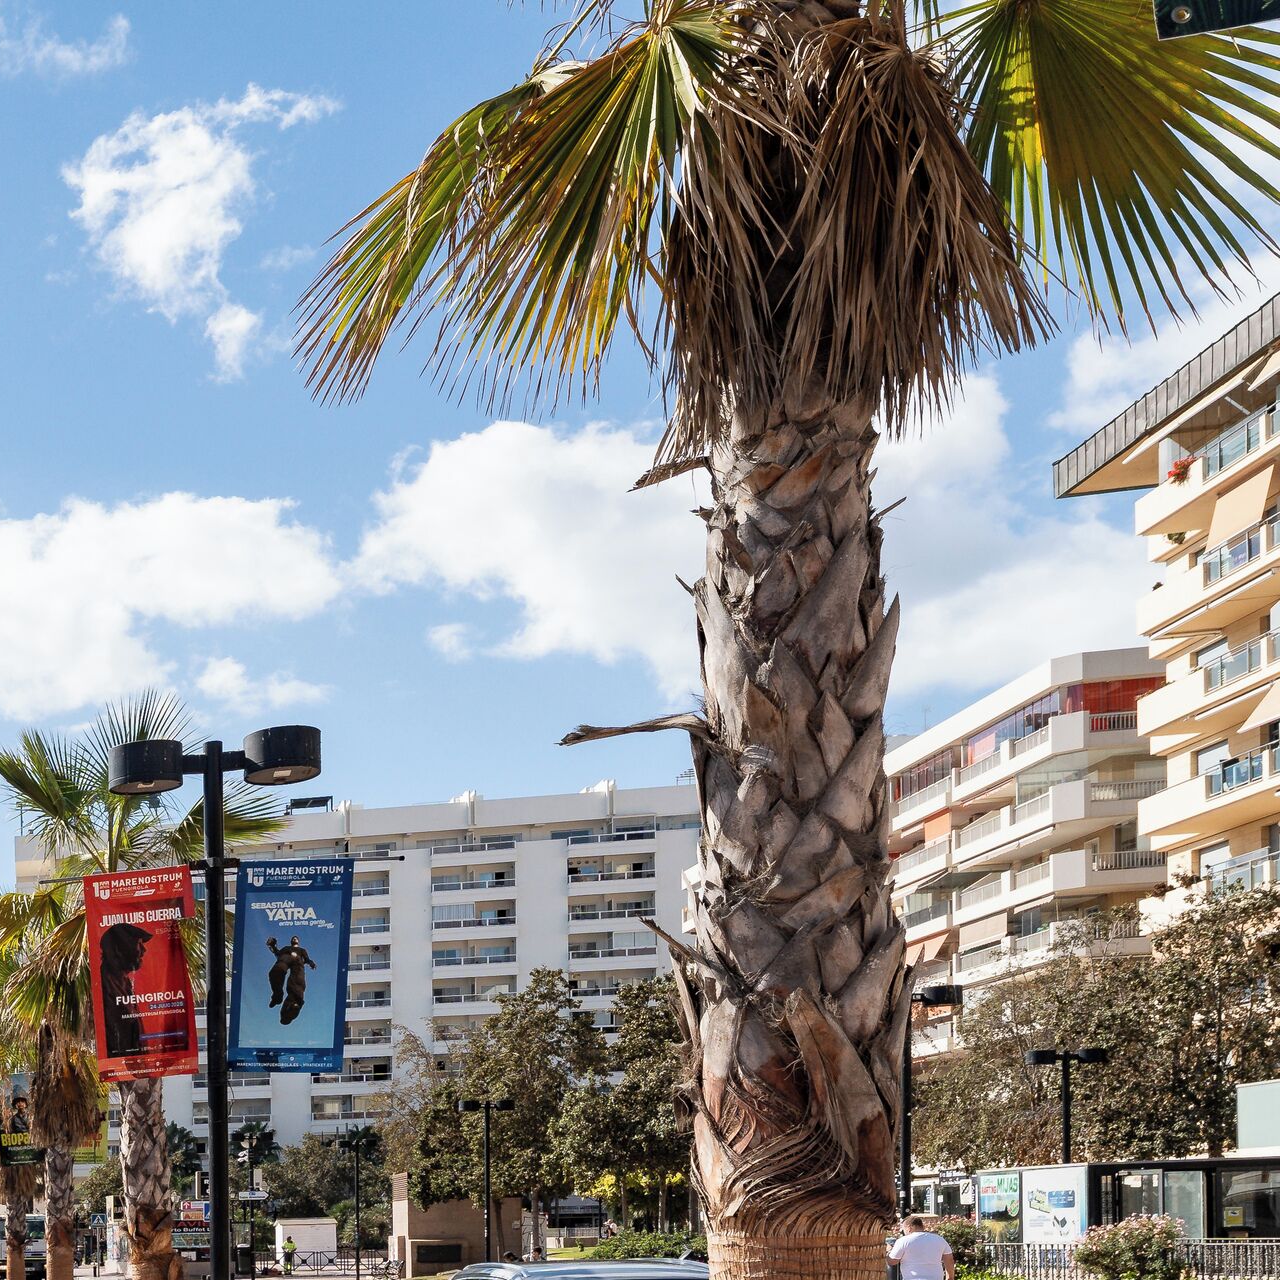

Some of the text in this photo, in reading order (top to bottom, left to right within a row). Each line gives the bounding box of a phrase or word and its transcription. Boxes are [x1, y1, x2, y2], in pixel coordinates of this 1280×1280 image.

[111, 885, 149, 893] FUENGIROLA
[251, 900, 295, 910] SEBASTIÁN
[100, 907, 182, 928] JUAN LUIS GUERRA
[265, 907, 317, 921] YATRA
[116, 990, 185, 1006] FUENGIROLA
[997, 1177, 1019, 1193] MIJAS
